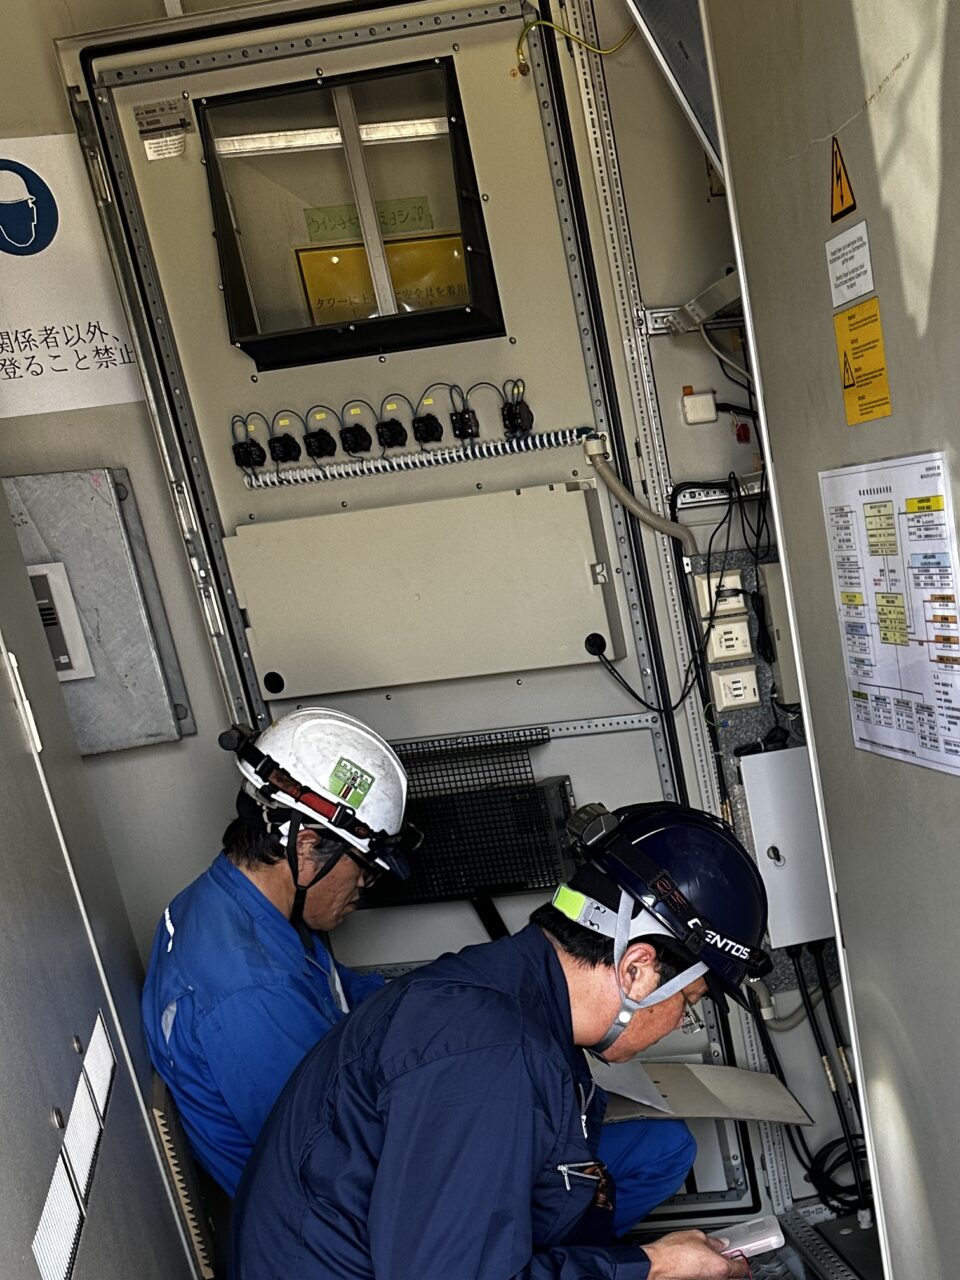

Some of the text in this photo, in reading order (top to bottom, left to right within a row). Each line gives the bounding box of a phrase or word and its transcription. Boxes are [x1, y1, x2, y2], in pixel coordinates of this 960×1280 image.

[0, 343, 137, 380] 登ること禁止
